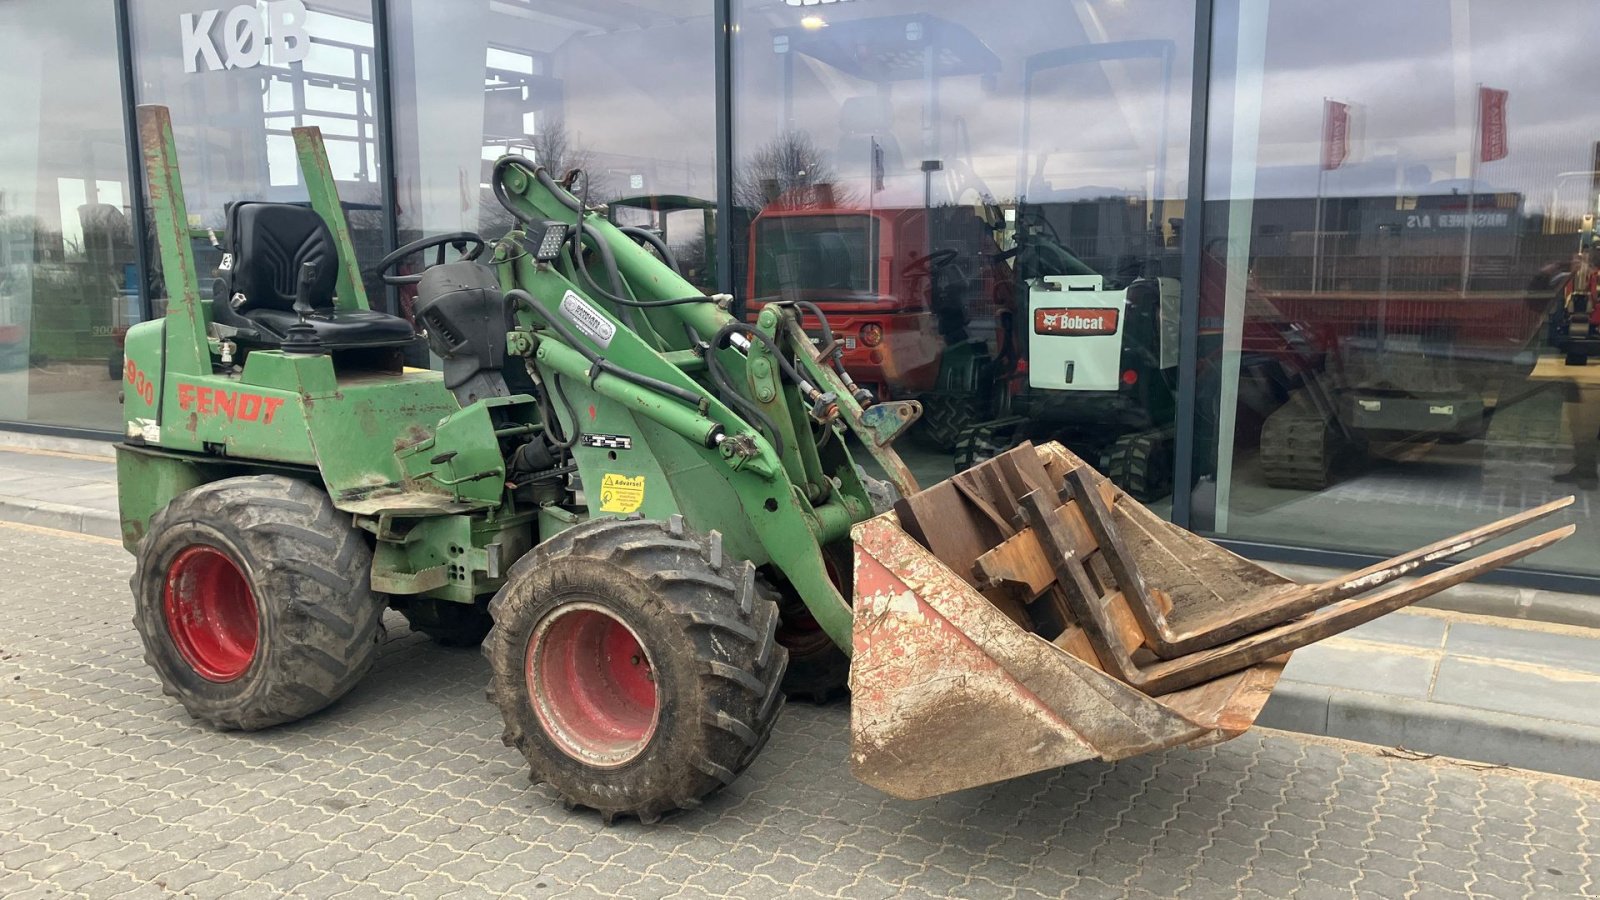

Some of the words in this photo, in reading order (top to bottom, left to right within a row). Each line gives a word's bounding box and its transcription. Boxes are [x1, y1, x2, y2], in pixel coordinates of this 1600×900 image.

[180, 0, 311, 73] KØB
[1060, 316, 1104, 330] Bobcat
[127, 359, 153, 406] 930
[177, 383, 284, 424] FENDT
[615, 479, 642, 487] Advarsel
